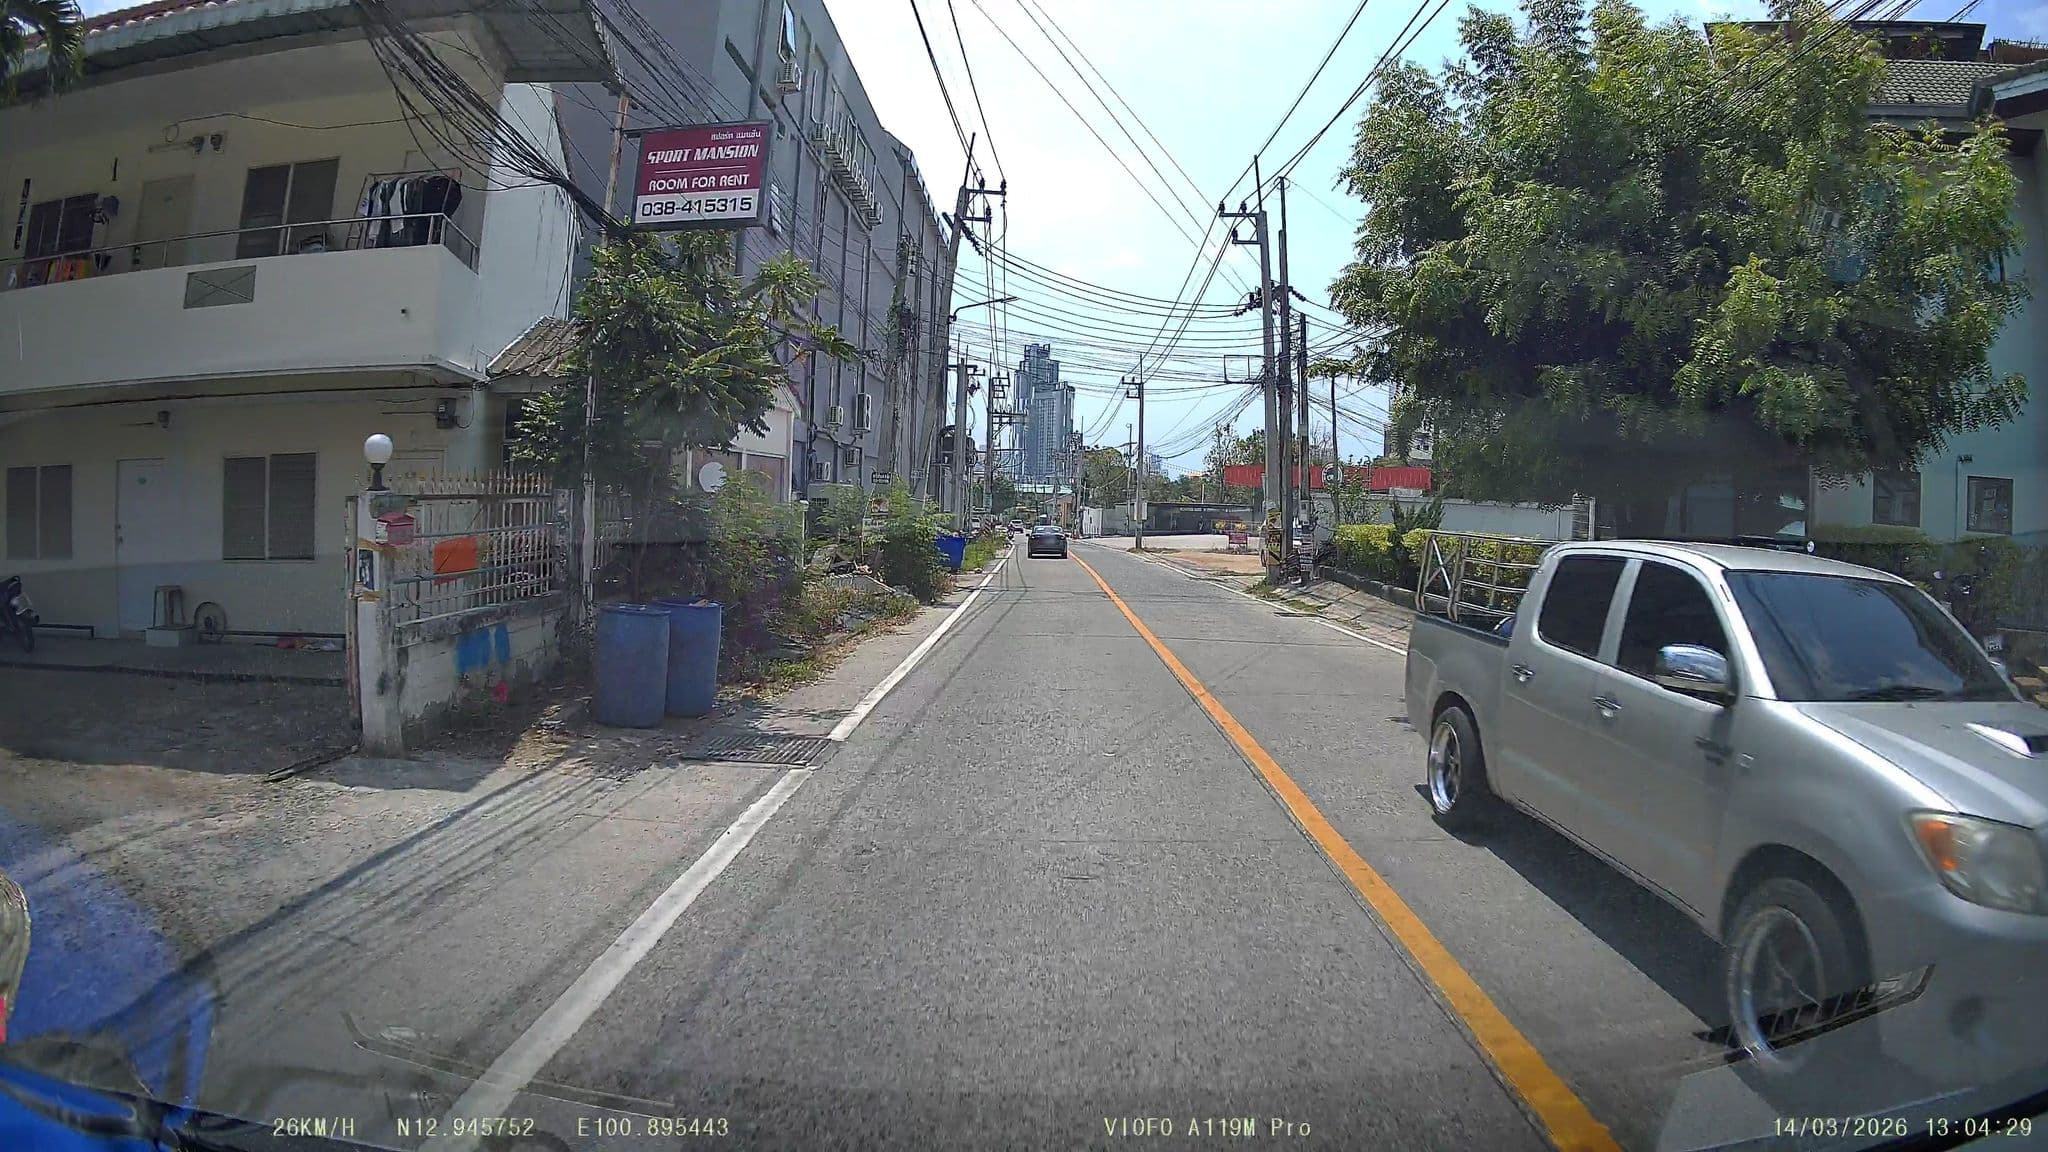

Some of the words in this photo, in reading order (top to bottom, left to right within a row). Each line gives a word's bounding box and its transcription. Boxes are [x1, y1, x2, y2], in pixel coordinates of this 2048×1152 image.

[646, 148, 692, 164] SPORT
[693, 144, 760, 161] MANSION
[648, 179, 688, 191] ROOM
[691, 176, 717, 189] FOR
[719, 174, 750, 187] RENT
[641, 197, 753, 217] 038-415315
